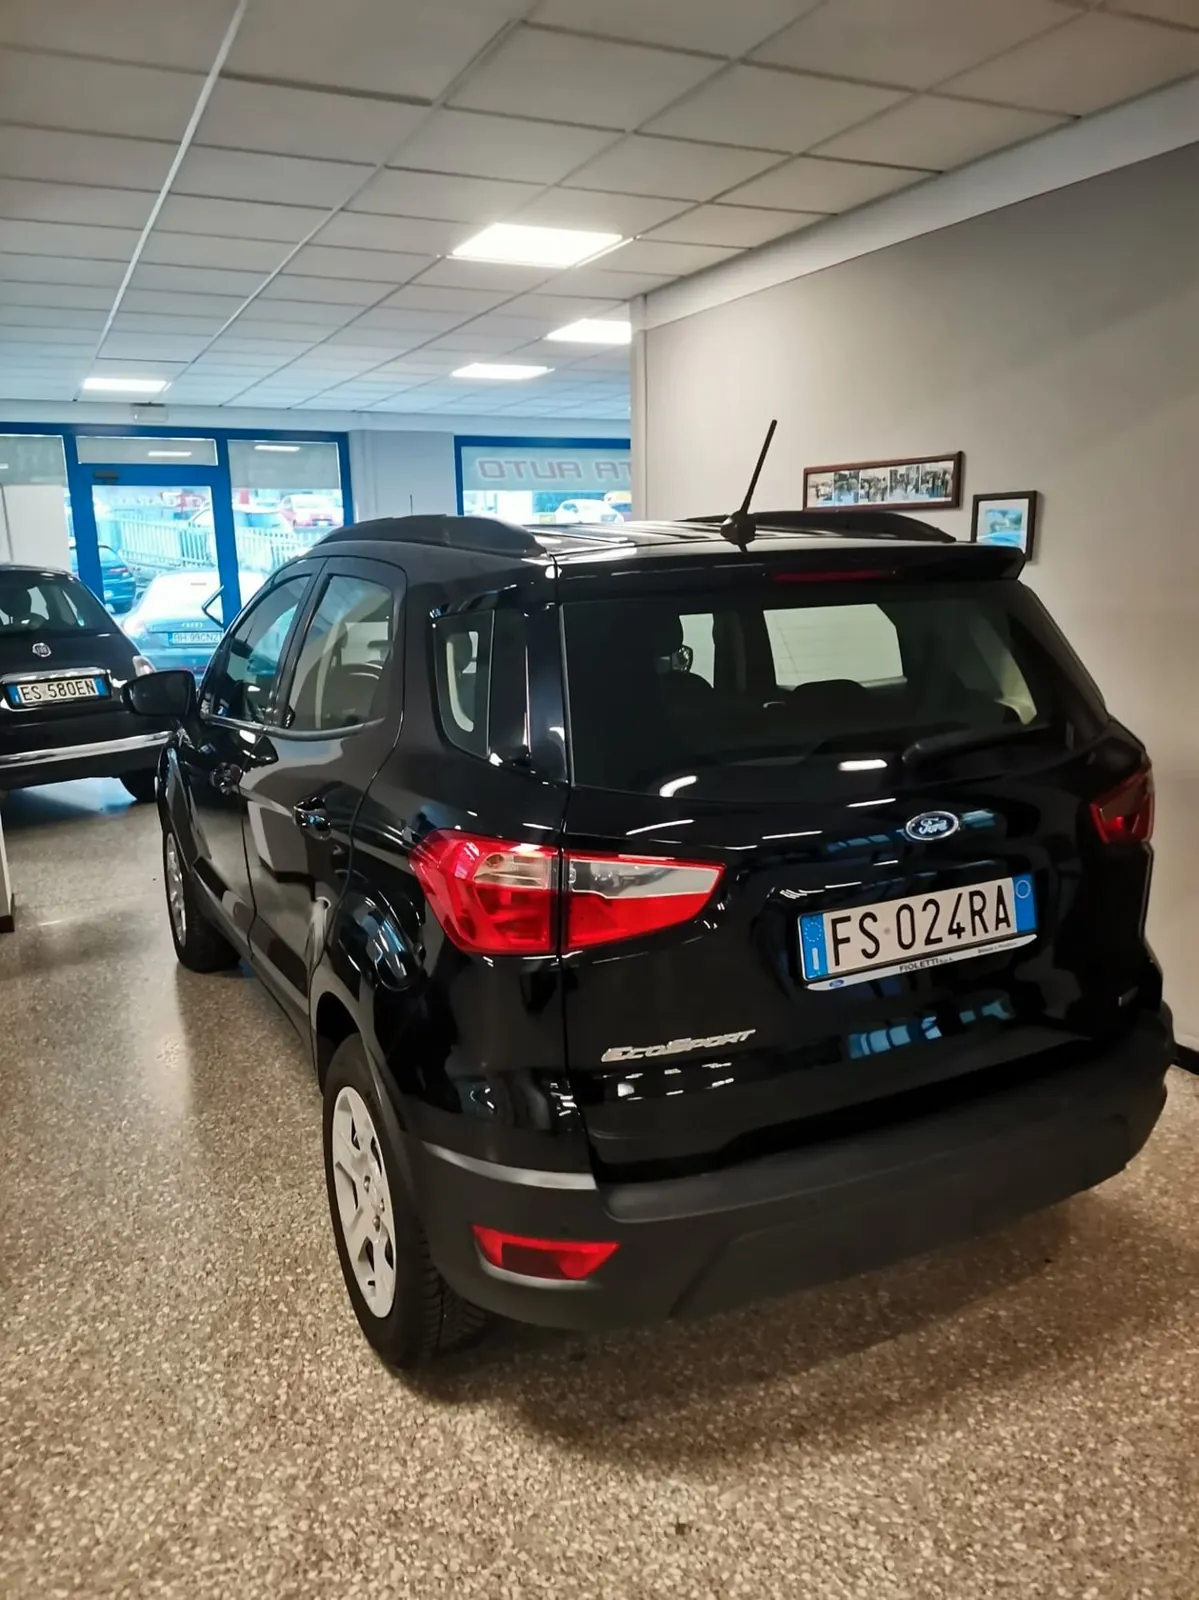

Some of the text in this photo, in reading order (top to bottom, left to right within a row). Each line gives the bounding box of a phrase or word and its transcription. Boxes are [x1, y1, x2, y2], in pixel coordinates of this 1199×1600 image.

[20, 685, 42, 702] ES
[47, 680, 97, 698] 580EN
[830, 911, 881, 967] FS
[896, 884, 1012, 950] 024RA
[899, 957, 939, 972] FIOLETTI
